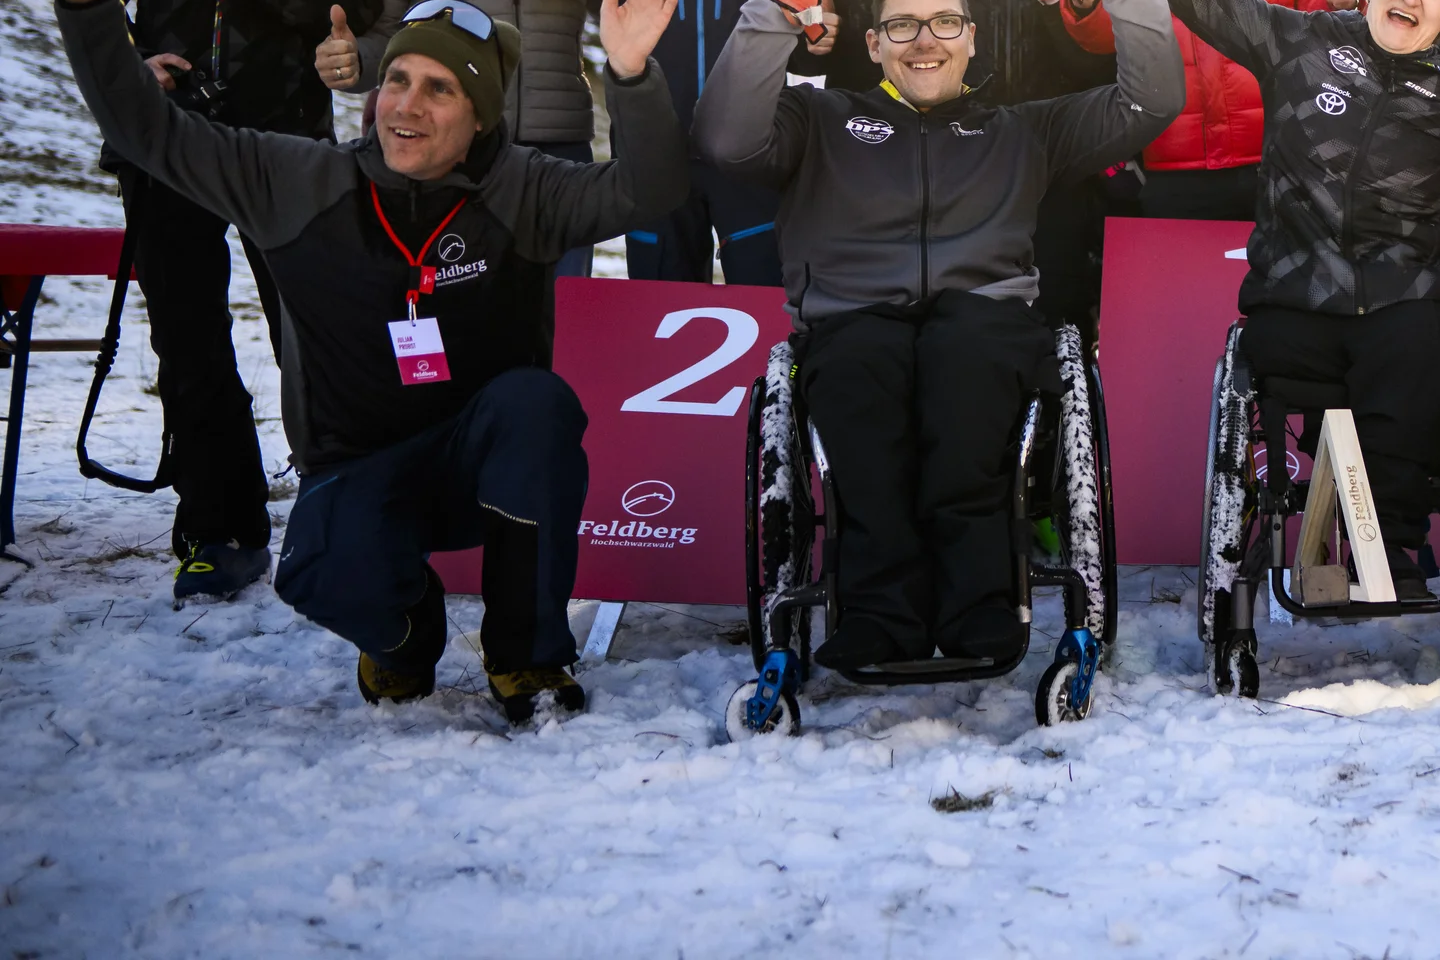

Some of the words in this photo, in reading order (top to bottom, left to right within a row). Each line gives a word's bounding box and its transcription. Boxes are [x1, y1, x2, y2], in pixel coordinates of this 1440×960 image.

[845, 119, 895, 135] DPS
[434, 259, 488, 281] eldberg
[620, 306, 760, 417] 2
[1345, 465, 1366, 521] Feldberg
[577, 520, 698, 544] Feldberg
[590, 538, 675, 549] Hochschwarzwald
